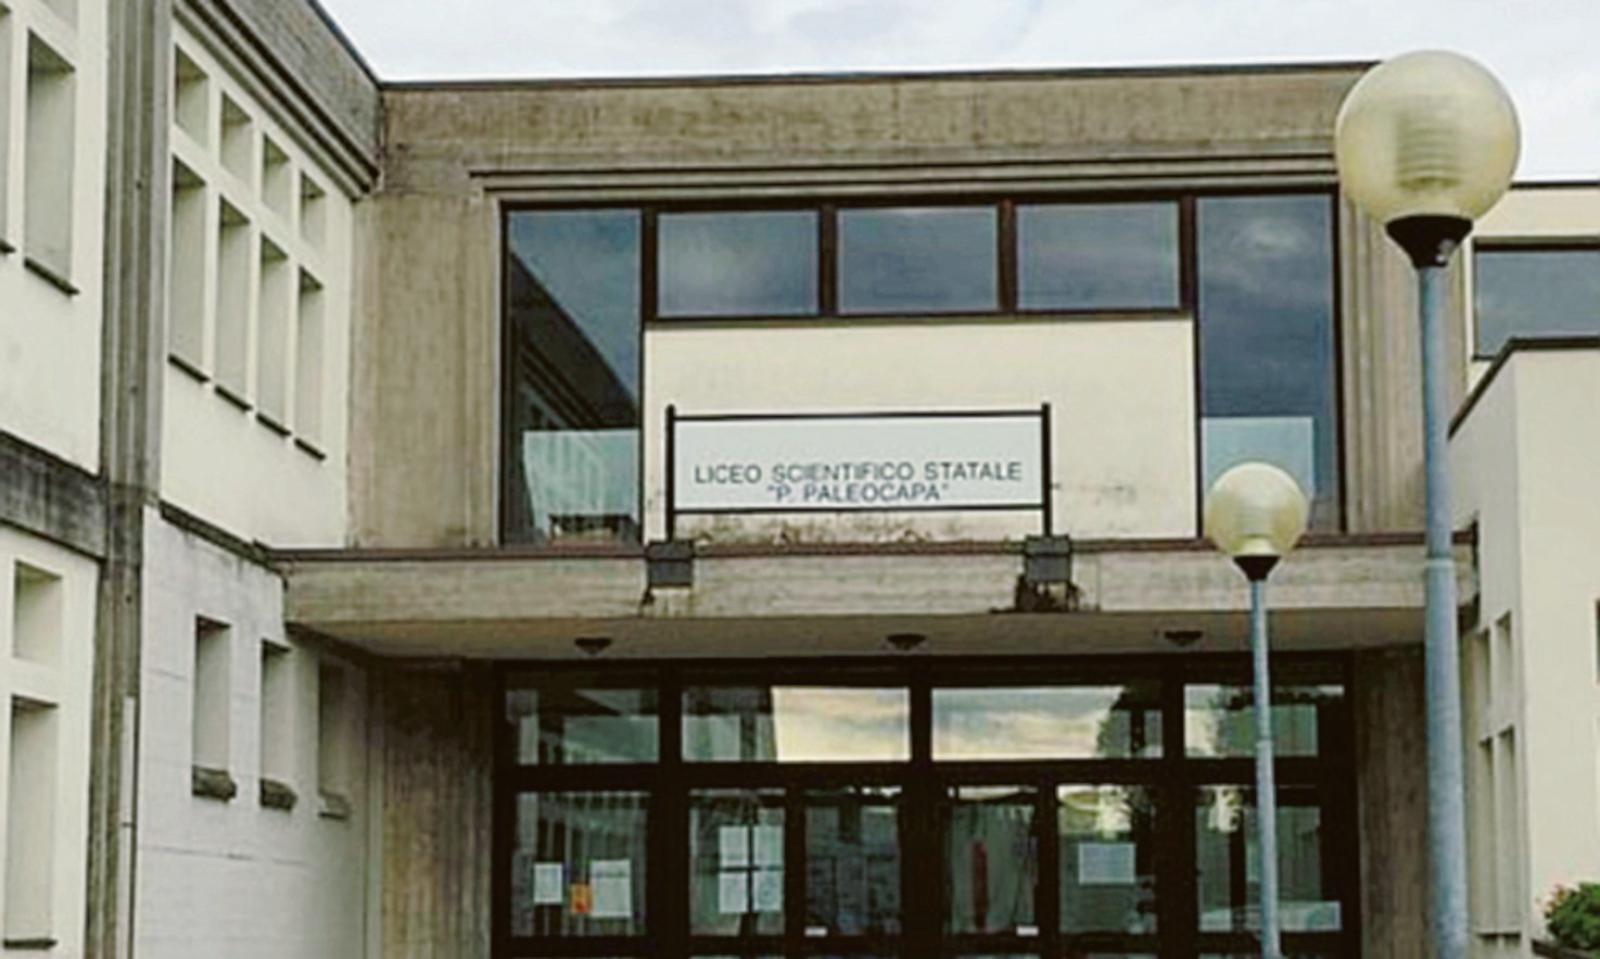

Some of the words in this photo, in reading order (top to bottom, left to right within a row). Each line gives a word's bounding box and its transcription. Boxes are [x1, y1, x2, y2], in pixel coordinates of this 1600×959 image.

[694, 463, 762, 484] LICEO
[772, 462, 914, 483] SCIENTIFICO
[924, 461, 1022, 481] STATALE
